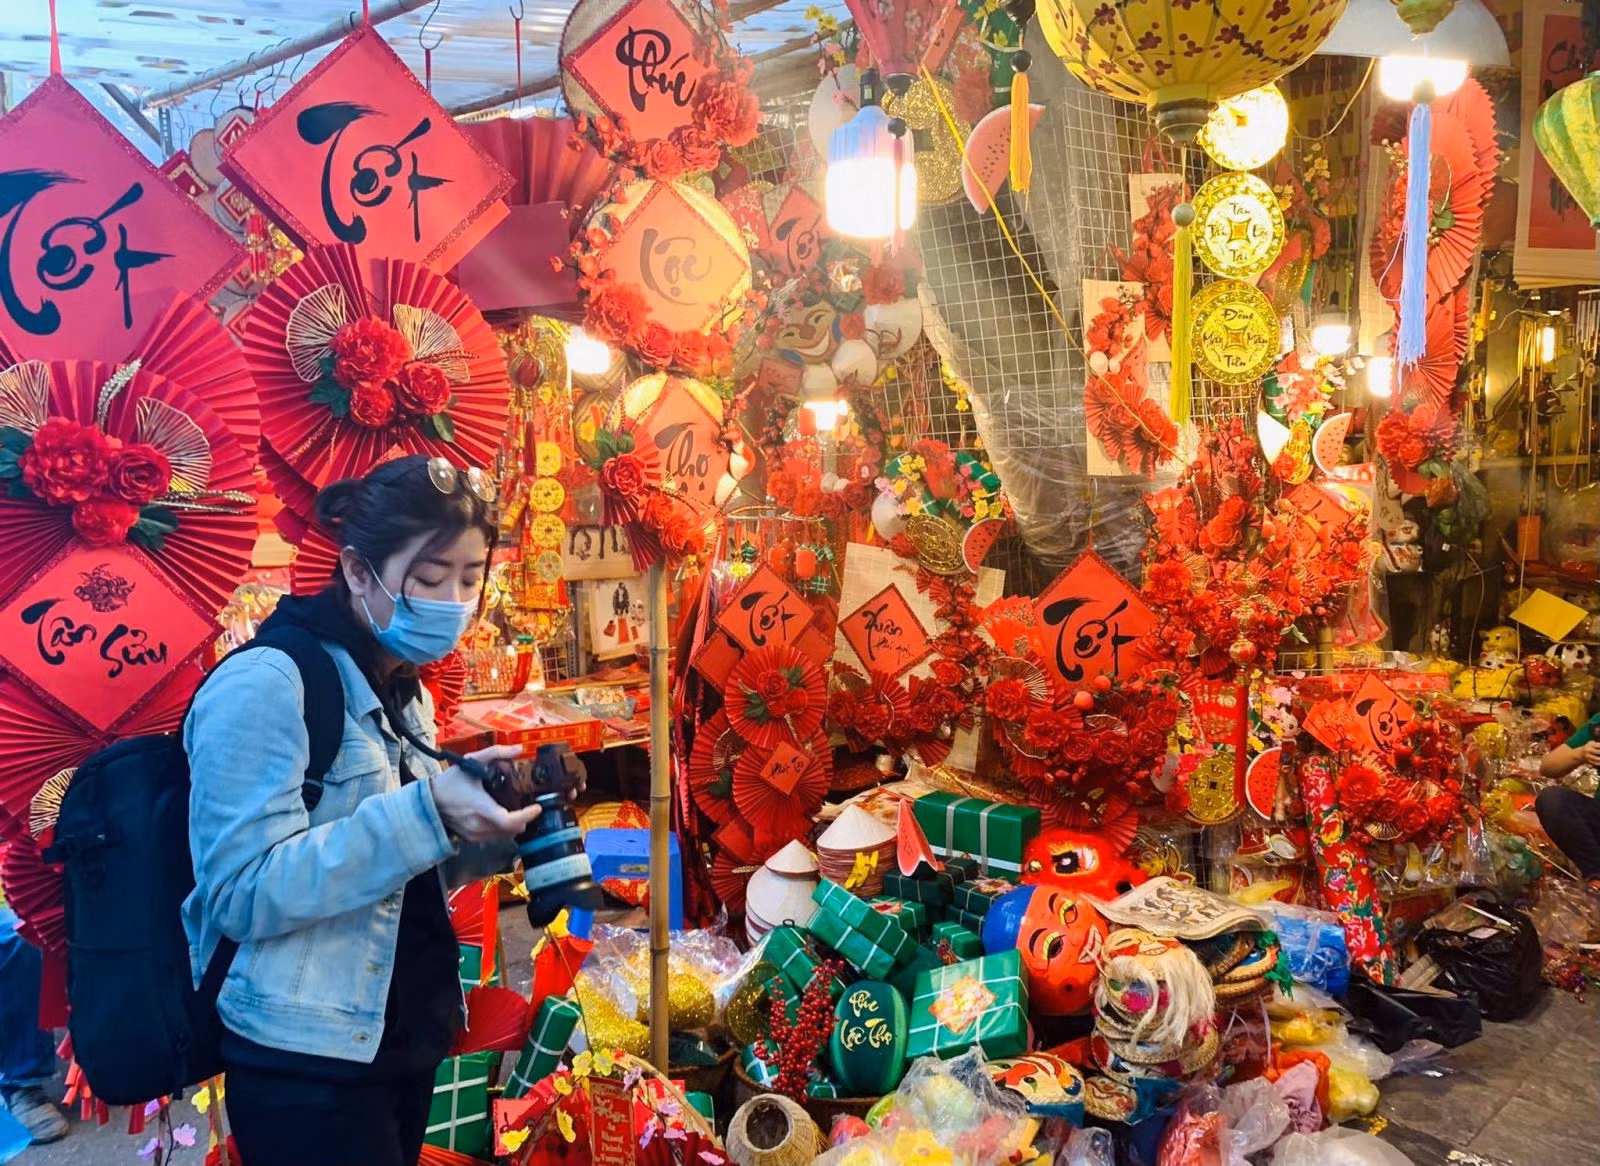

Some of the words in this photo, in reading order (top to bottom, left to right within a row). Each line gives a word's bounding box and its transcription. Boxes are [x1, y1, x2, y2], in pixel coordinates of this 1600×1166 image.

[616, 25, 697, 112] Phúc
[297, 101, 454, 245] Tết
[0, 168, 176, 336] Tết
[640, 228, 713, 306] Lộc
[21, 598, 97, 666] Tân
[100, 623, 168, 678] Sửu
[741, 591, 799, 646] Tết
[862, 603, 903, 662] Xuân
[1043, 596, 1142, 682] Tết
